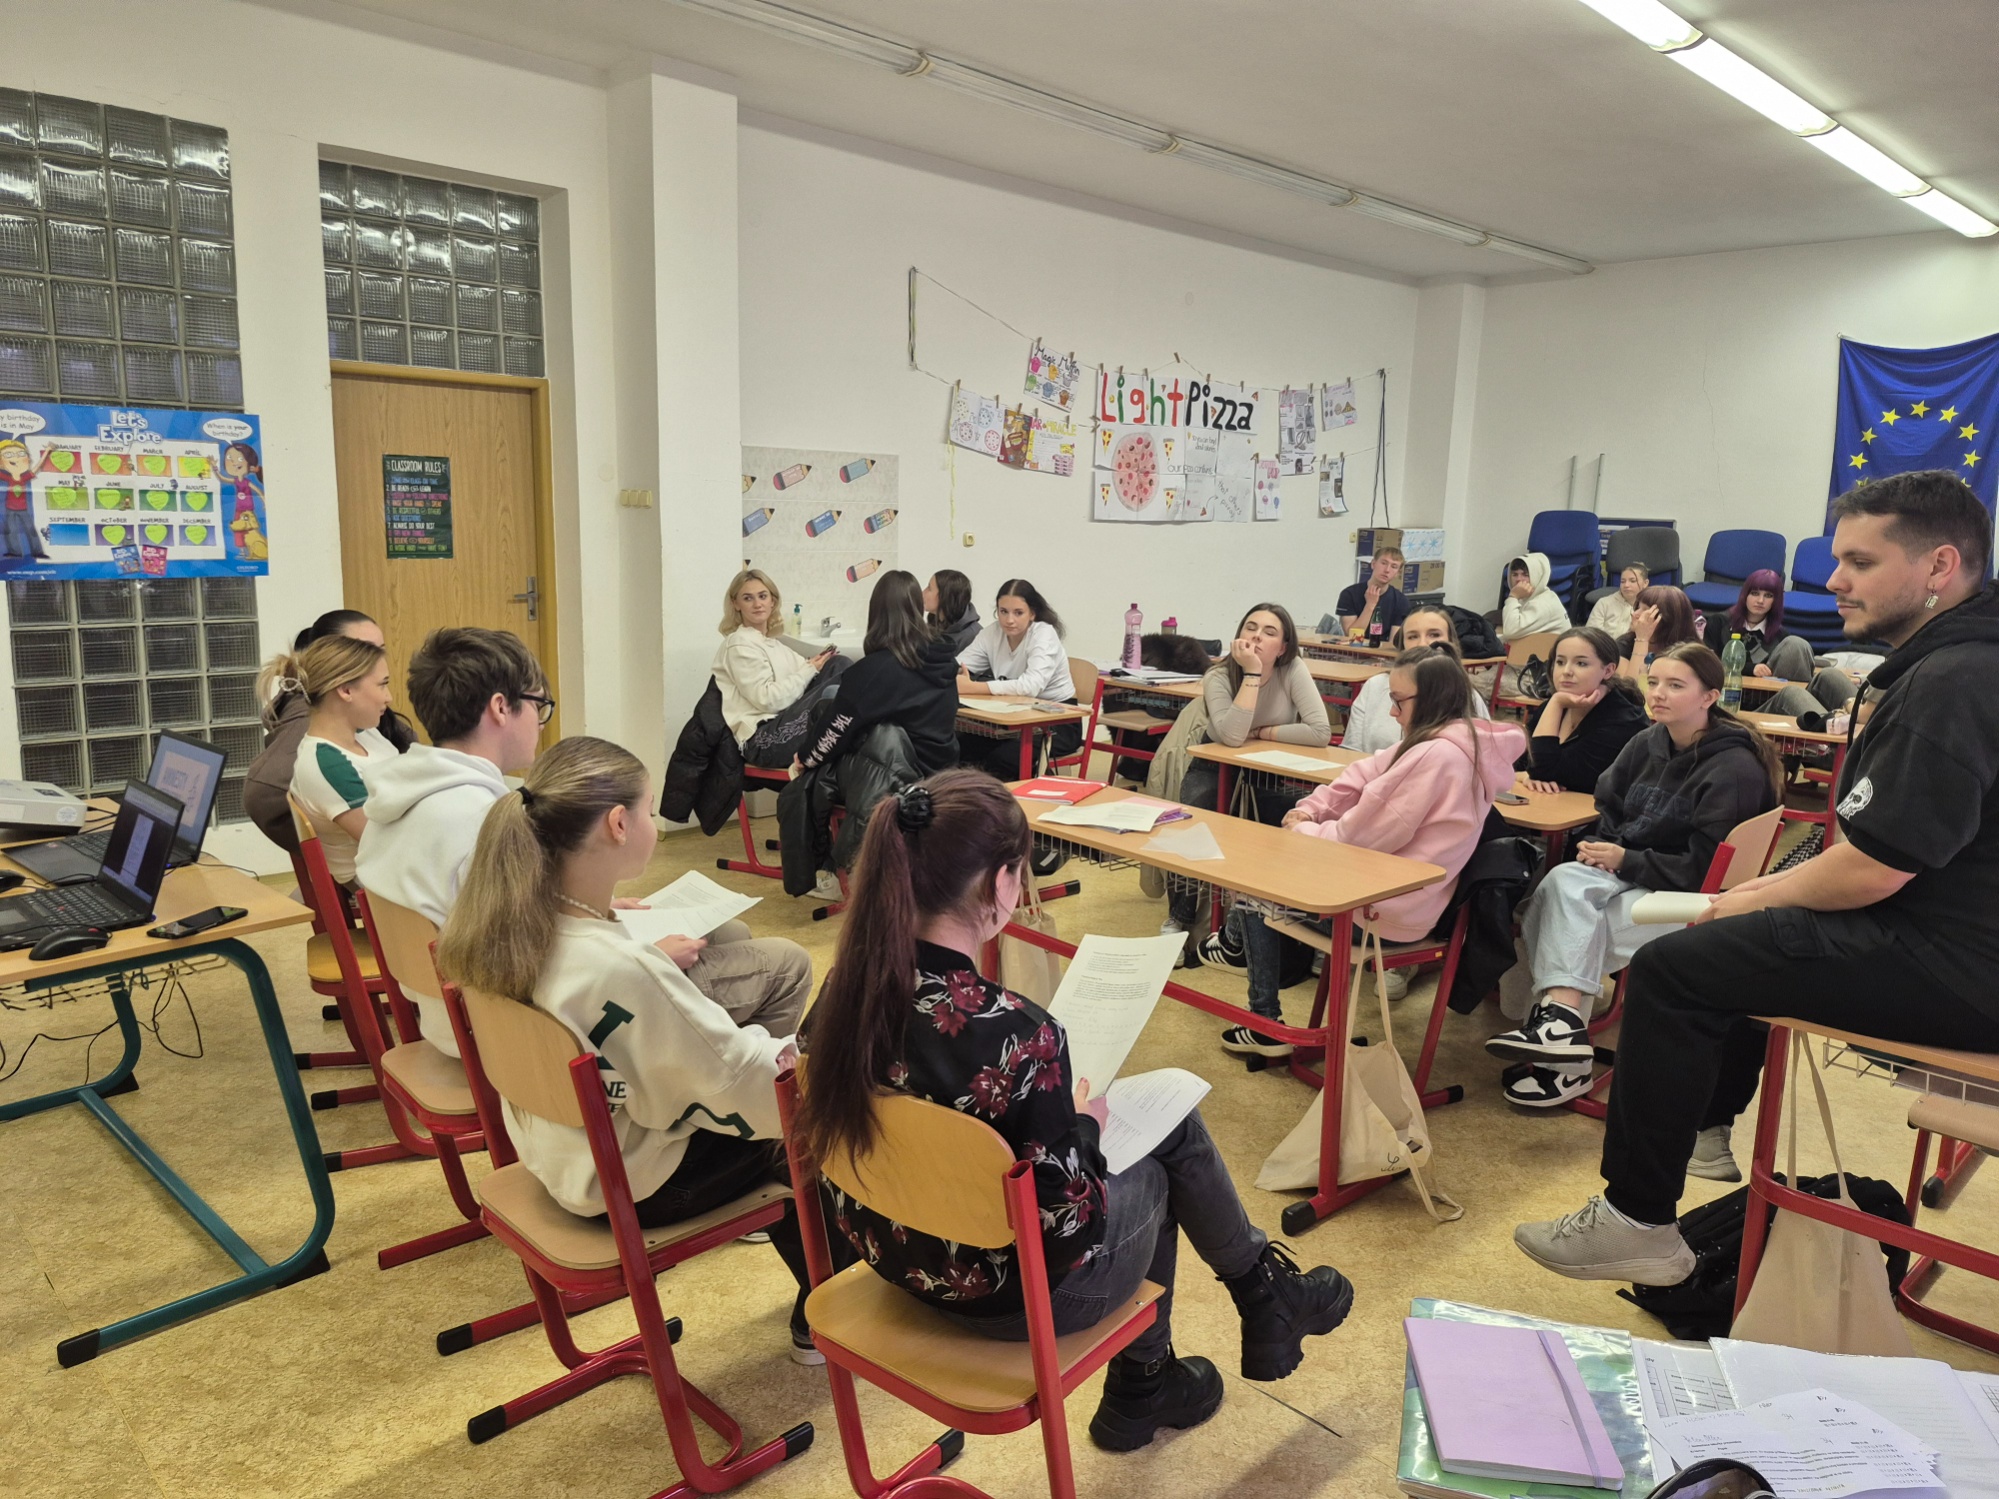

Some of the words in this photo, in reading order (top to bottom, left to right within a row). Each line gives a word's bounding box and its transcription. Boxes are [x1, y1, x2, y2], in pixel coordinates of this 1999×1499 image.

[1101, 372, 1184, 427] Light
[1185, 381, 1254, 431] Pizza
[7, 414, 40, 422] birthday
[19, 422, 34, 430] May
[111, 410, 148, 429] Let's
[99, 425, 162, 446] Explore
[391, 460, 422, 472] CLASSROOM
[425, 461, 442, 474] RULES
[830, 714, 854, 732] THE
